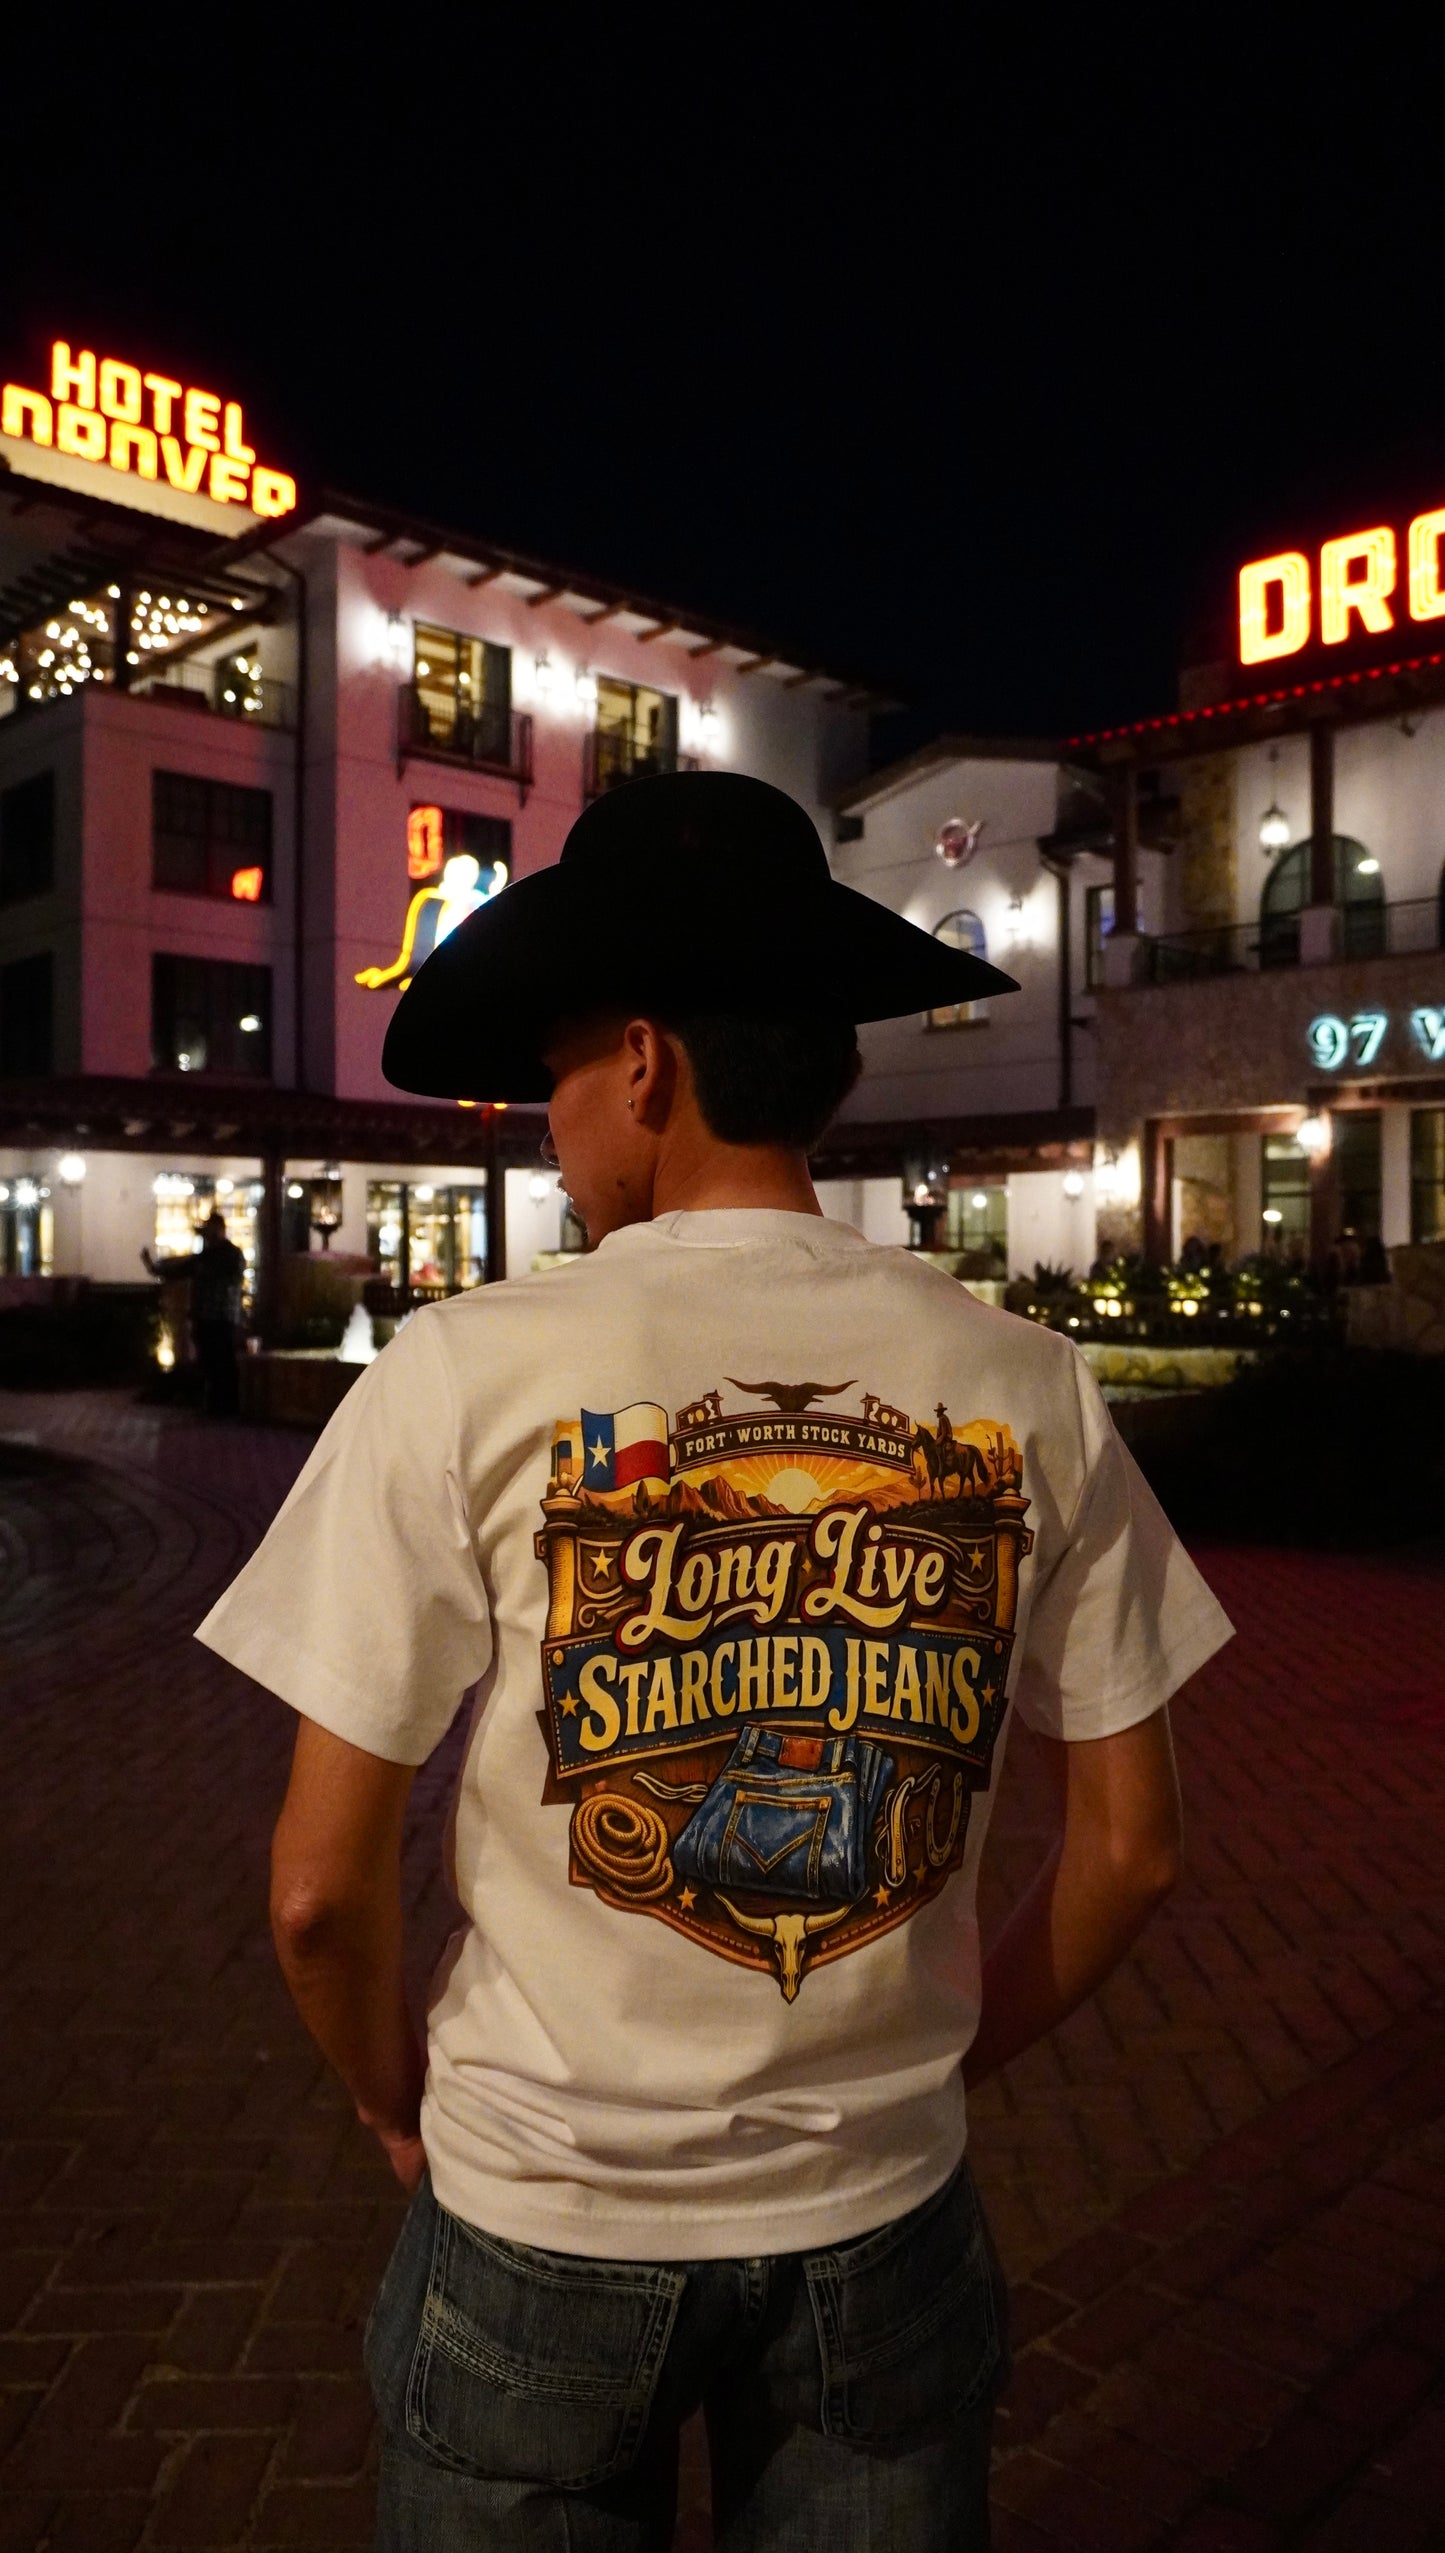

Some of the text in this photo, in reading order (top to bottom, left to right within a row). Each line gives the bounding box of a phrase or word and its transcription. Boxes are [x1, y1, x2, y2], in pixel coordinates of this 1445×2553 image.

[50, 340, 256, 464] HOTEL
[1308, 1013, 1388, 1070] 97
[685, 1424, 906, 1459] FORT WORTH STOCK YARDS
[620, 1506, 946, 1647] Long Live
[578, 1635, 982, 1752] STARCHED JEANS
